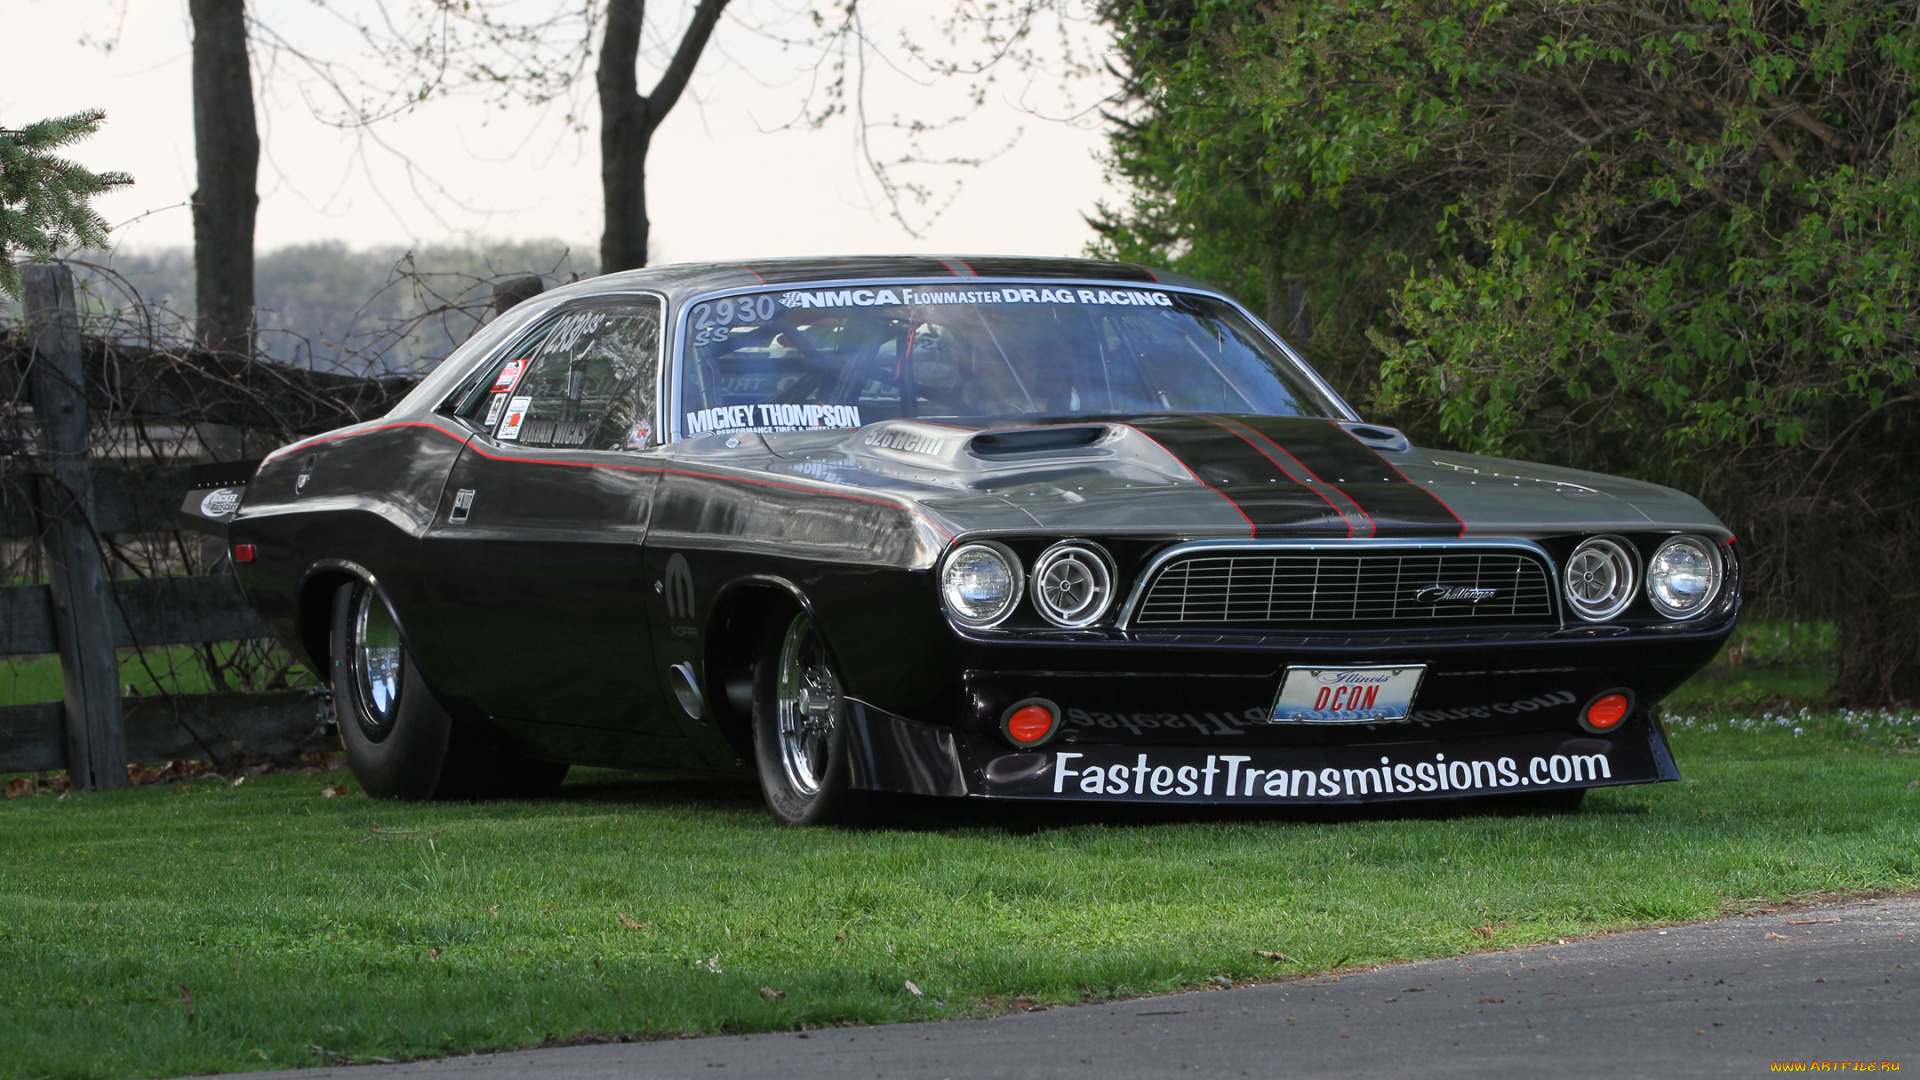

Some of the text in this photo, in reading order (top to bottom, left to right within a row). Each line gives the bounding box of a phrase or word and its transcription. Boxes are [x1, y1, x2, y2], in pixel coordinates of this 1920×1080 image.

[799, 288, 1173, 308] NMCA FLOWMASTER DRAG RACING
[693, 295, 775, 330] 2930
[693, 327, 729, 347] SS
[687, 404, 861, 434] MICKEY THOMPSON
[716, 426, 773, 435] PERFORMANCE
[864, 429, 895, 448] 526
[1416, 586, 1496, 604] Challenger
[1316, 670, 1391, 684] Illinois
[1314, 685, 1380, 711] DCON
[1053, 752, 1612, 798] FastestTransmissions.com
